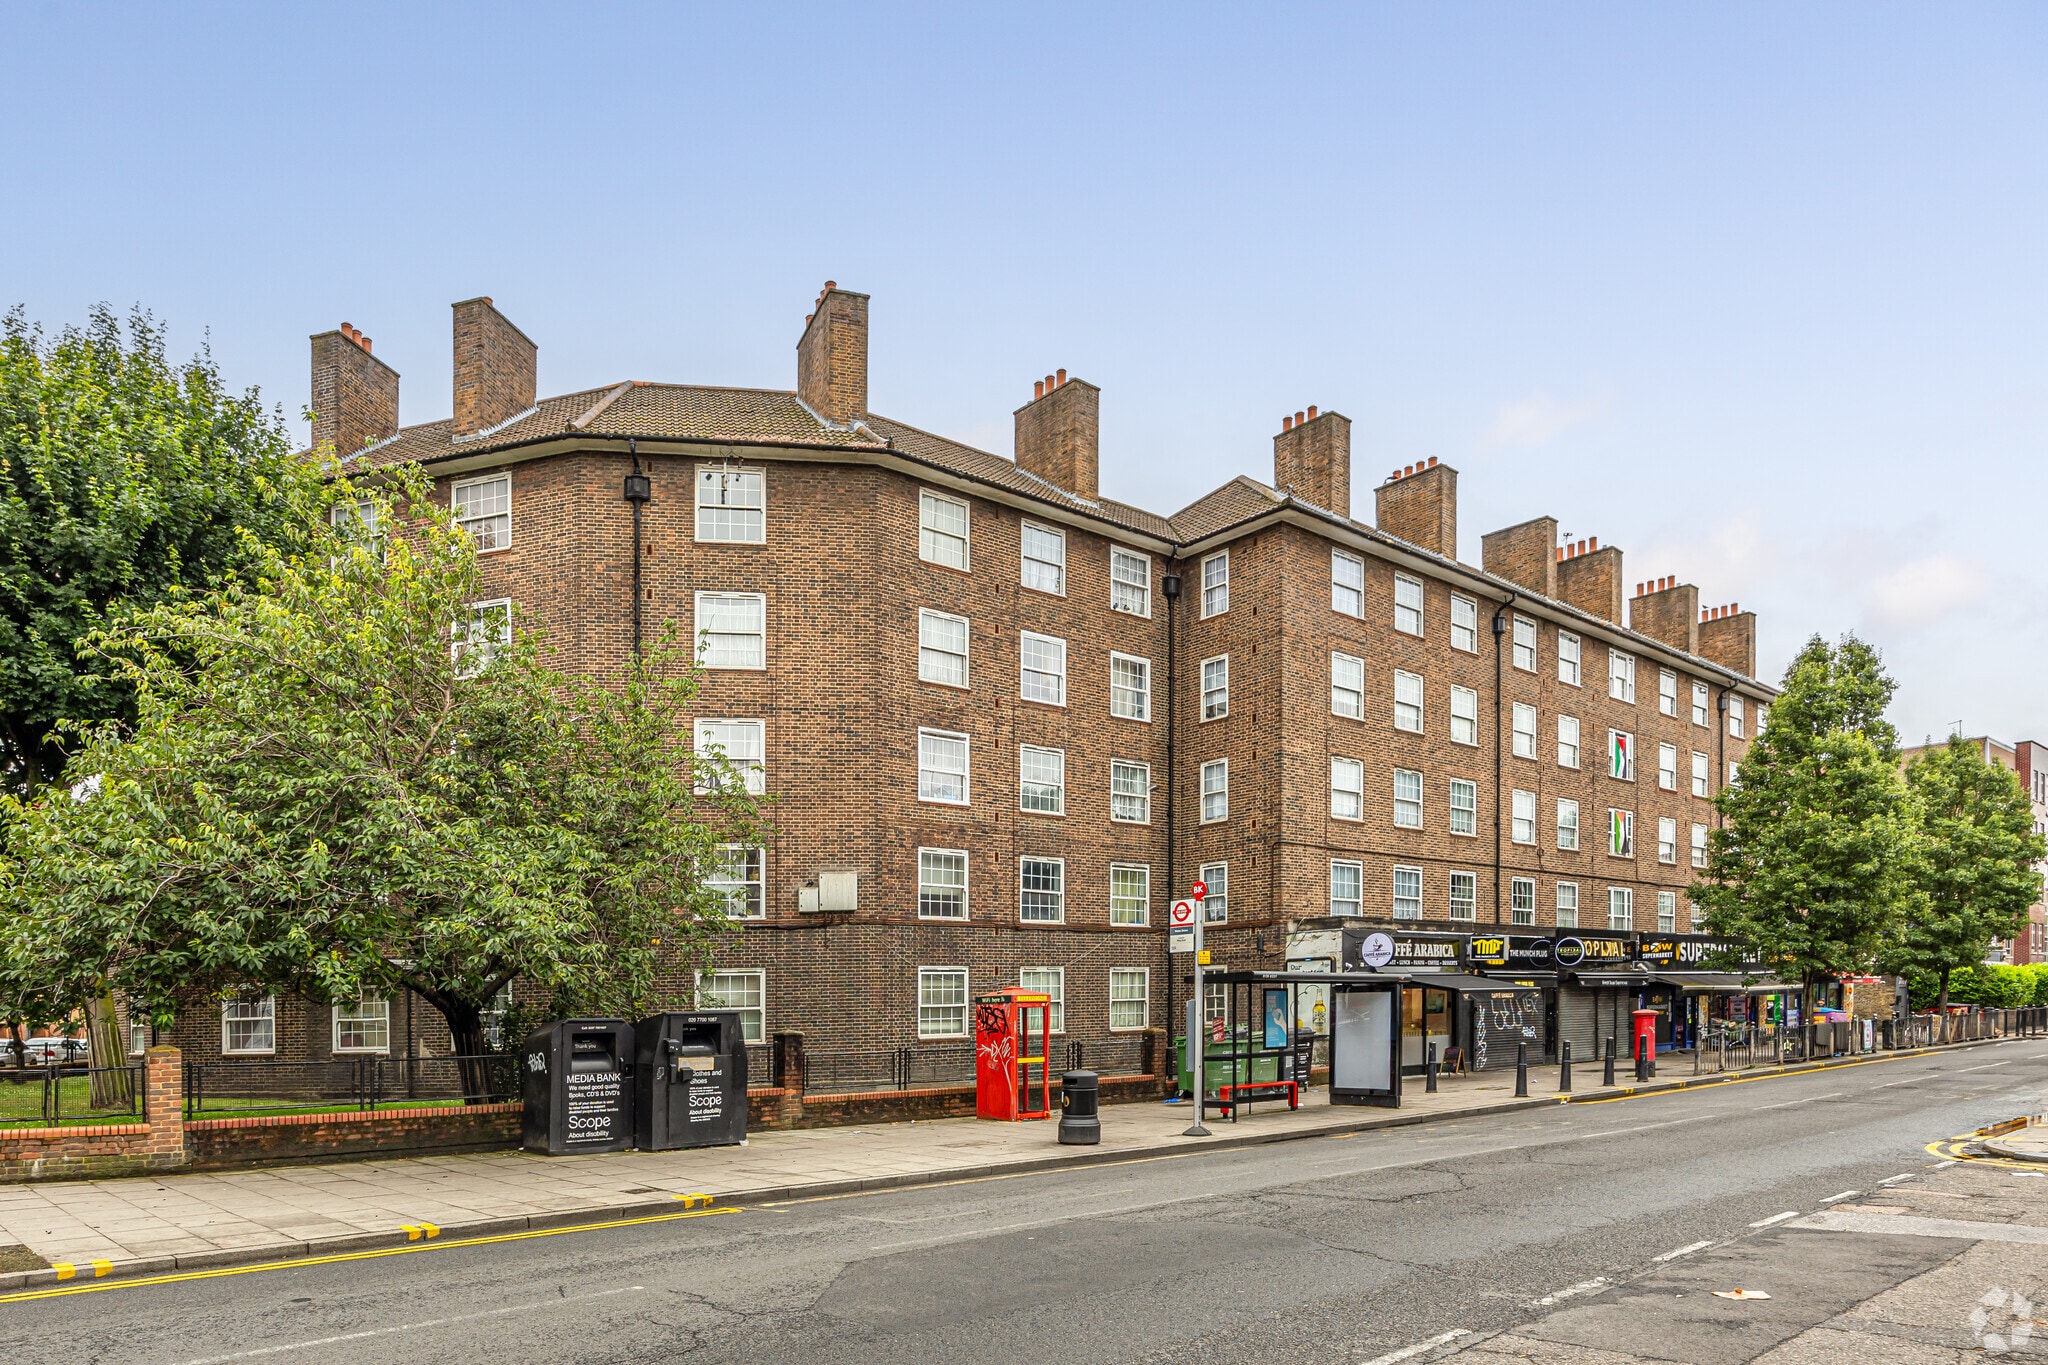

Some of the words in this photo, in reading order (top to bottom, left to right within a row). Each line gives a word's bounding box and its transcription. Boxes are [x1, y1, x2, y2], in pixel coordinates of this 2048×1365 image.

[1193, 885, 1203, 894] BK
[1413, 943, 1454, 957] ARABICA
[1472, 939, 1503, 954] TMP
[1509, 949, 1518, 957] THE
[1519, 949, 1535, 957] MUNCH
[1536, 950, 1548, 958] PLUG
[566, 1074, 596, 1084] MEDIA
[596, 1072, 621, 1083] BANK
[591, 1083, 604, 1091] good
[689, 1095, 722, 1108] Scope
[568, 1115, 611, 1131] Scope
